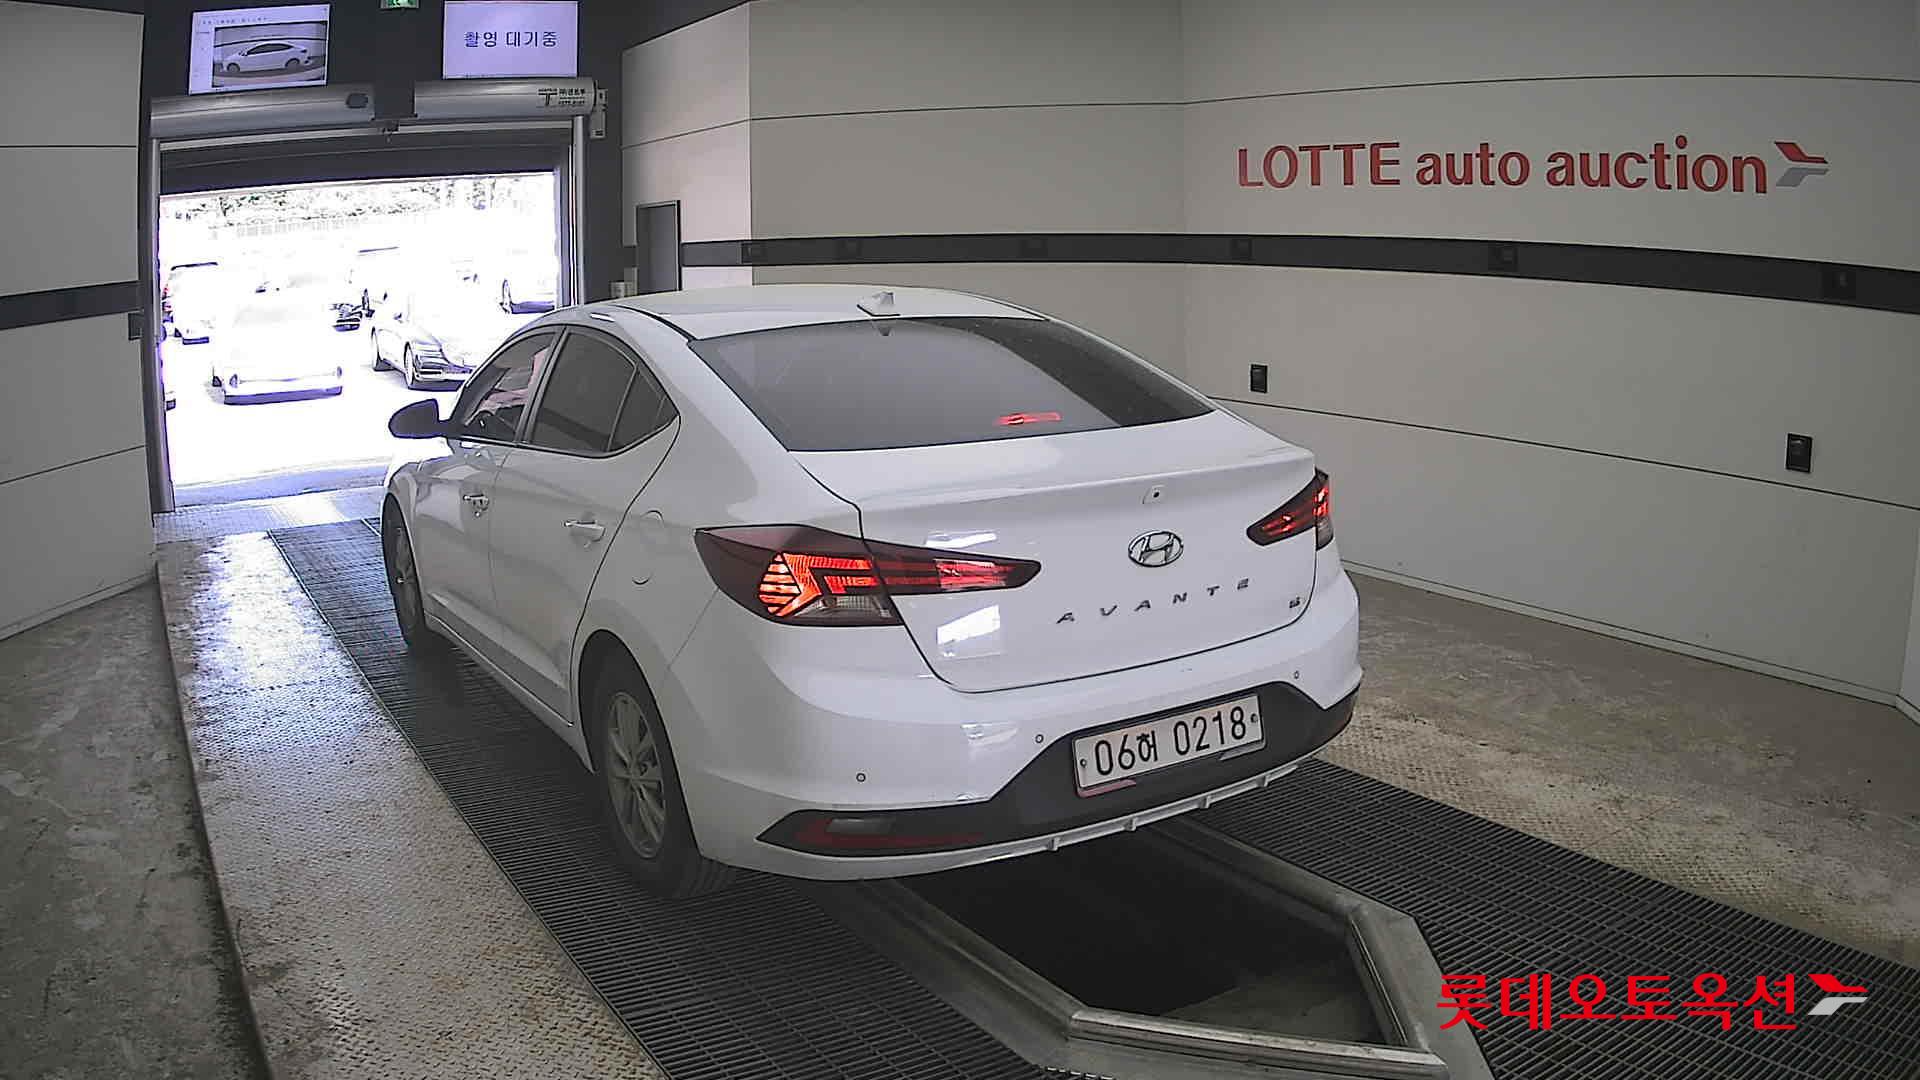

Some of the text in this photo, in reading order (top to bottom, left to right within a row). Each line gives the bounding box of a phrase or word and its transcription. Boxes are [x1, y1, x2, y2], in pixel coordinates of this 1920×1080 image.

[465, 31, 557, 48] 촬영 대기중
[1238, 134, 1767, 194] LOTTE auto auction
[1056, 577, 1250, 625] AVANTE
[1094, 706, 1247, 776] 06허 0218
